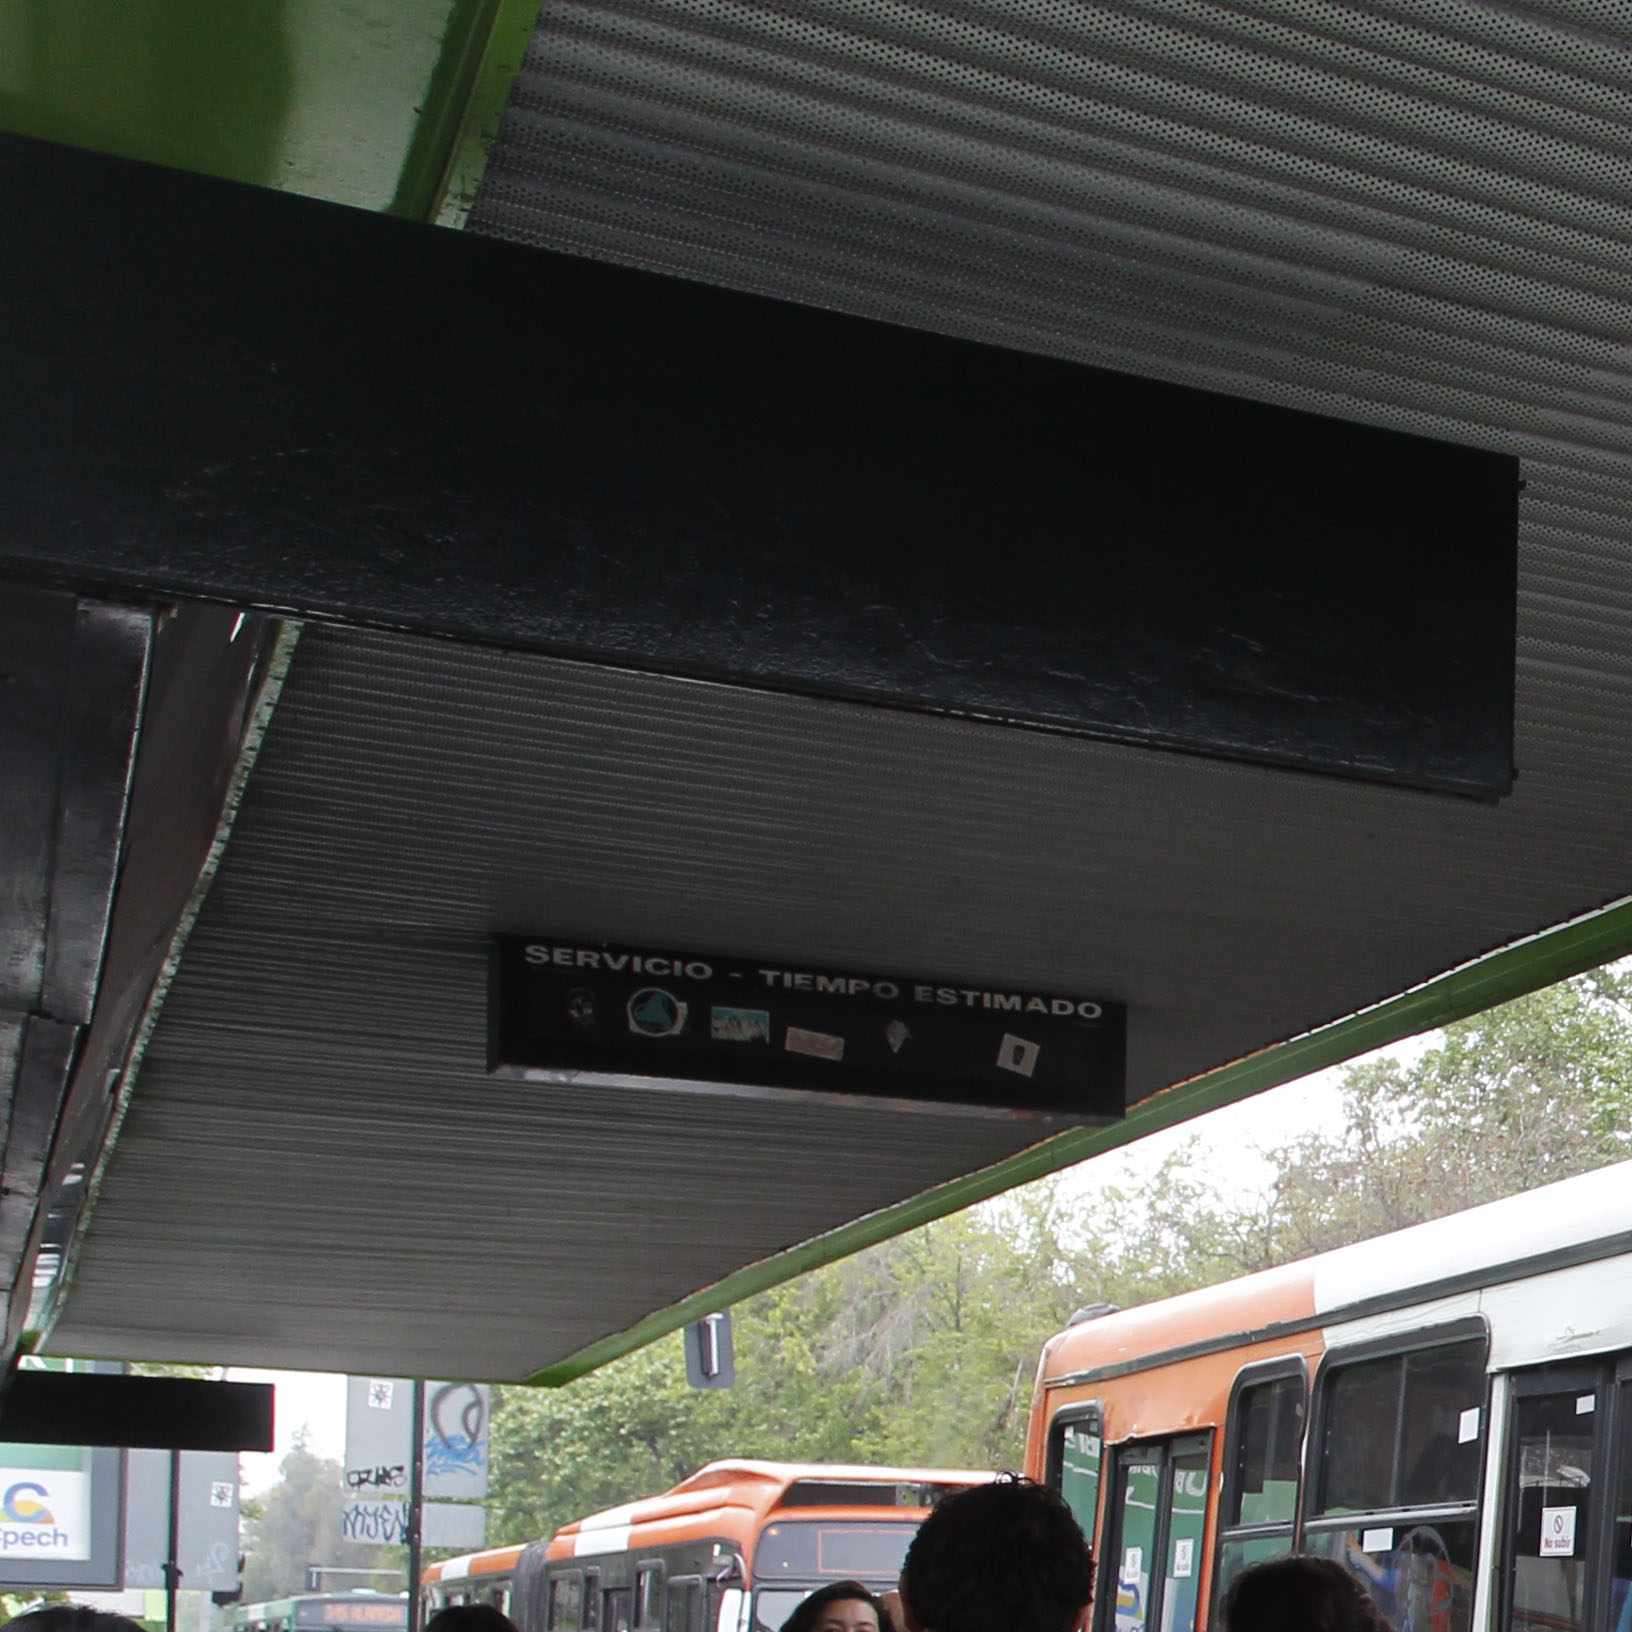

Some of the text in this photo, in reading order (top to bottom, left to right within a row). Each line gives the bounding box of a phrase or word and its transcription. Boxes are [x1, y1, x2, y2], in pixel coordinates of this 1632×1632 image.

[524, 944, 714, 982] SERVICIO
[758, 968, 900, 1002] TIEMPO
[914, 985, 1104, 1020] ESTIMADO
